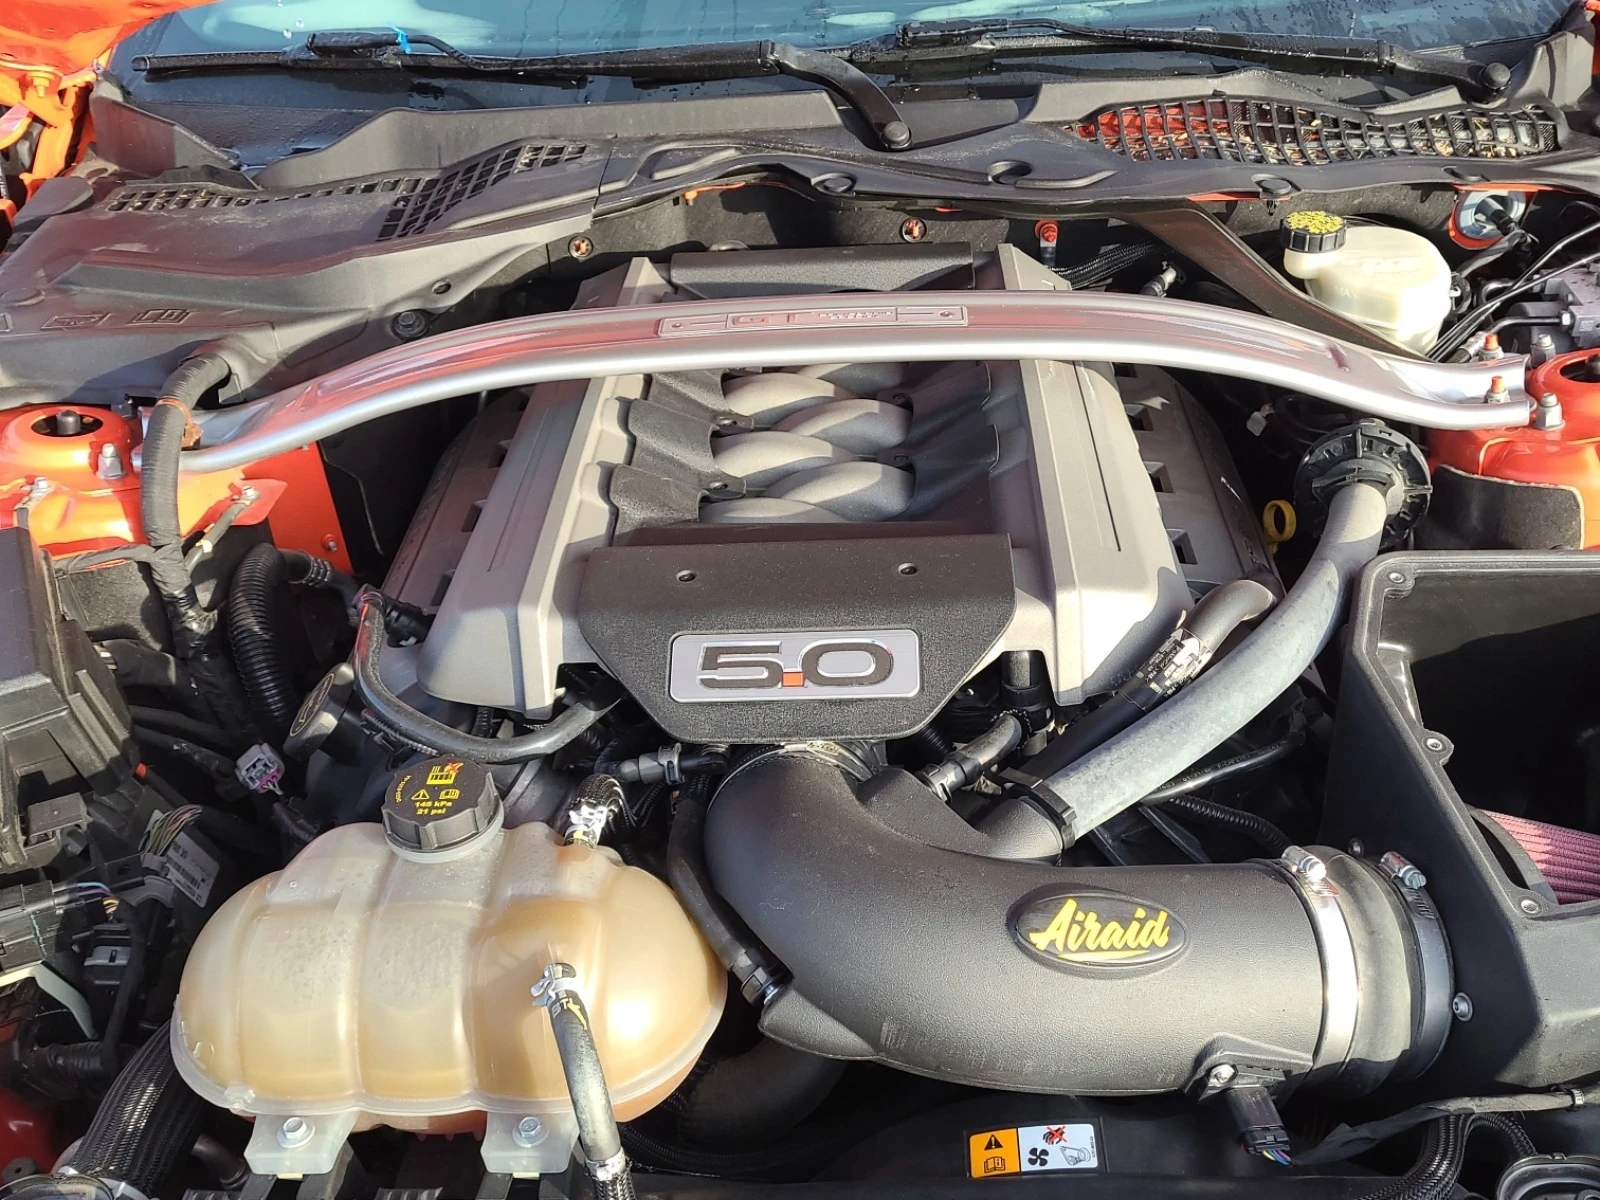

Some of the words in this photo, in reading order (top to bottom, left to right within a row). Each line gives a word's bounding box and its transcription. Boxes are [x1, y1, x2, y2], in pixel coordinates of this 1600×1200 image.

[697, 638, 894, 689] 5.0
[415, 800, 433, 808] 145
[1029, 898, 1170, 952] Airaid
